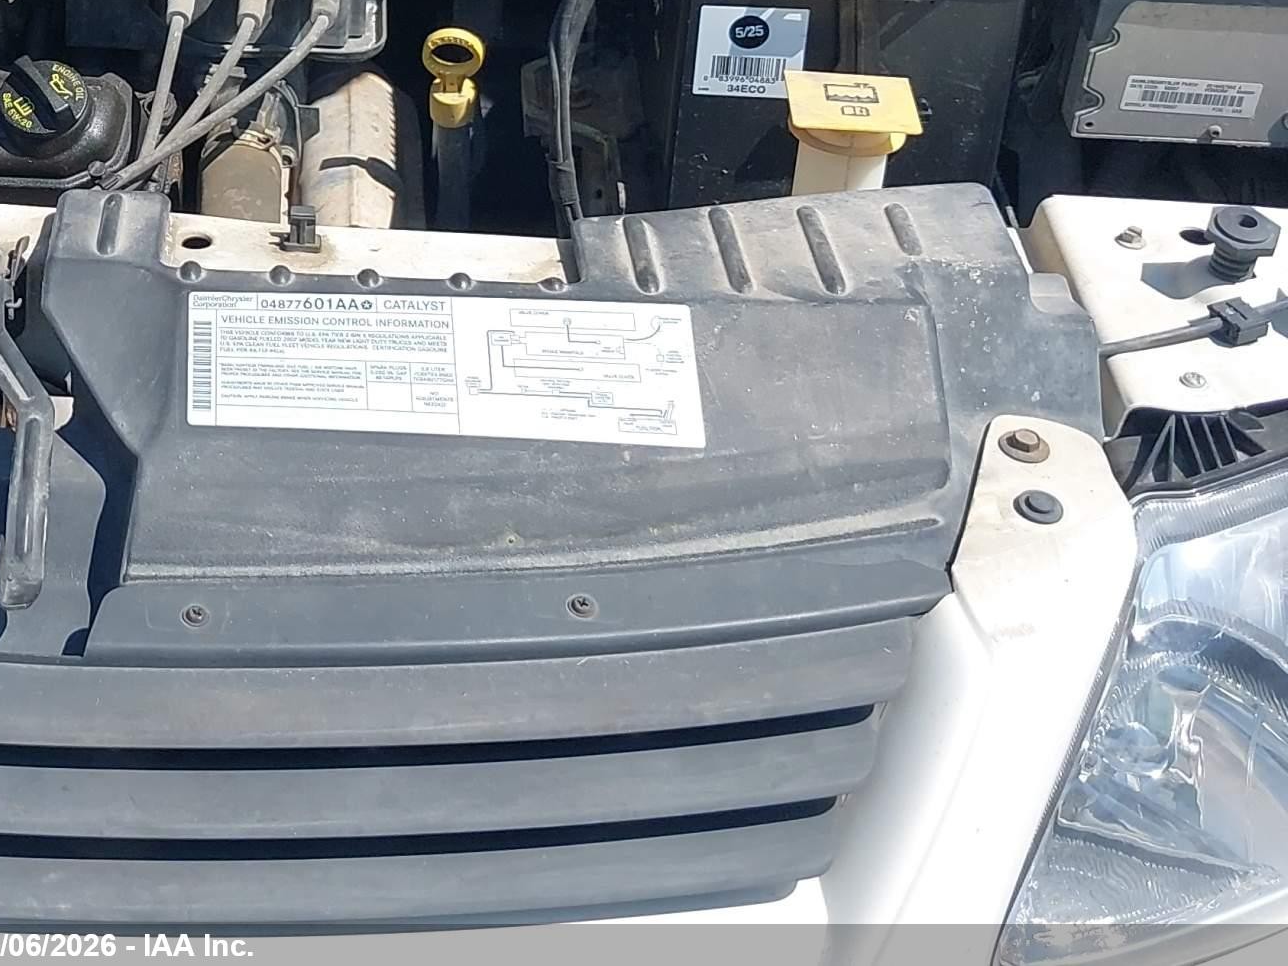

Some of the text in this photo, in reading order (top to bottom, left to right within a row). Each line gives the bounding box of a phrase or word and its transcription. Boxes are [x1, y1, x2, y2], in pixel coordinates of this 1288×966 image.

[735, 25, 764, 38] 5/25
[52, 64, 81, 87] ENGINE
[75, 88, 84, 101] OIL
[192, 294, 252, 303] DaimlerChrysler
[192, 300, 237, 308] Corporation
[260, 296, 360, 310] 04877601AA
[383, 299, 446, 311] CATALYST
[220, 314, 449, 329] VEHICLE EMISSION CONTROL INFORMATION
